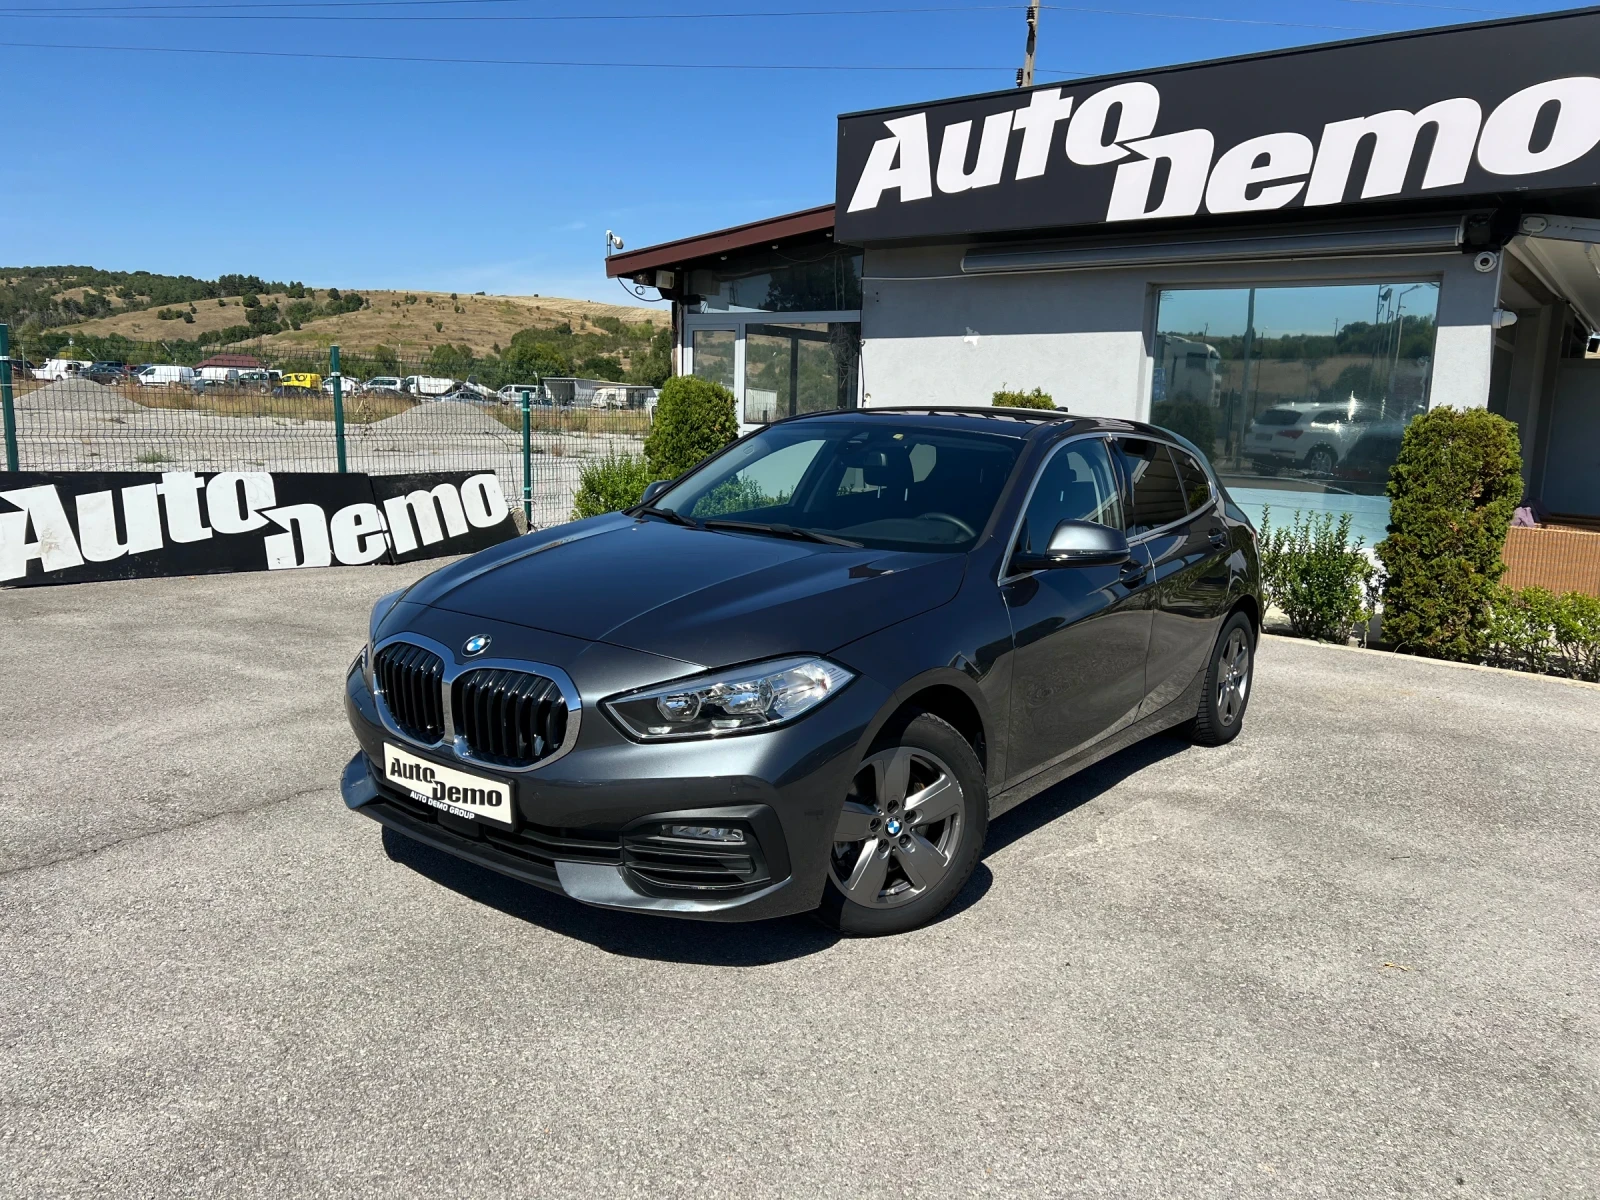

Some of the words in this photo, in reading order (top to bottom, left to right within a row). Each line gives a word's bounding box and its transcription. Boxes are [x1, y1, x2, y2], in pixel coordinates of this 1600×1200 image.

[847, 82, 1160, 213] Auto
[1106, 77, 1600, 221] Demo
[0, 472, 277, 581] Auto
[262, 473, 509, 570] Demo
[390, 757, 436, 784] Auto
[431, 780, 503, 807] Demo
[410, 791, 427, 803] AUTO
[428, 798, 448, 811] DEMO
[449, 806, 475, 820] GROUP
